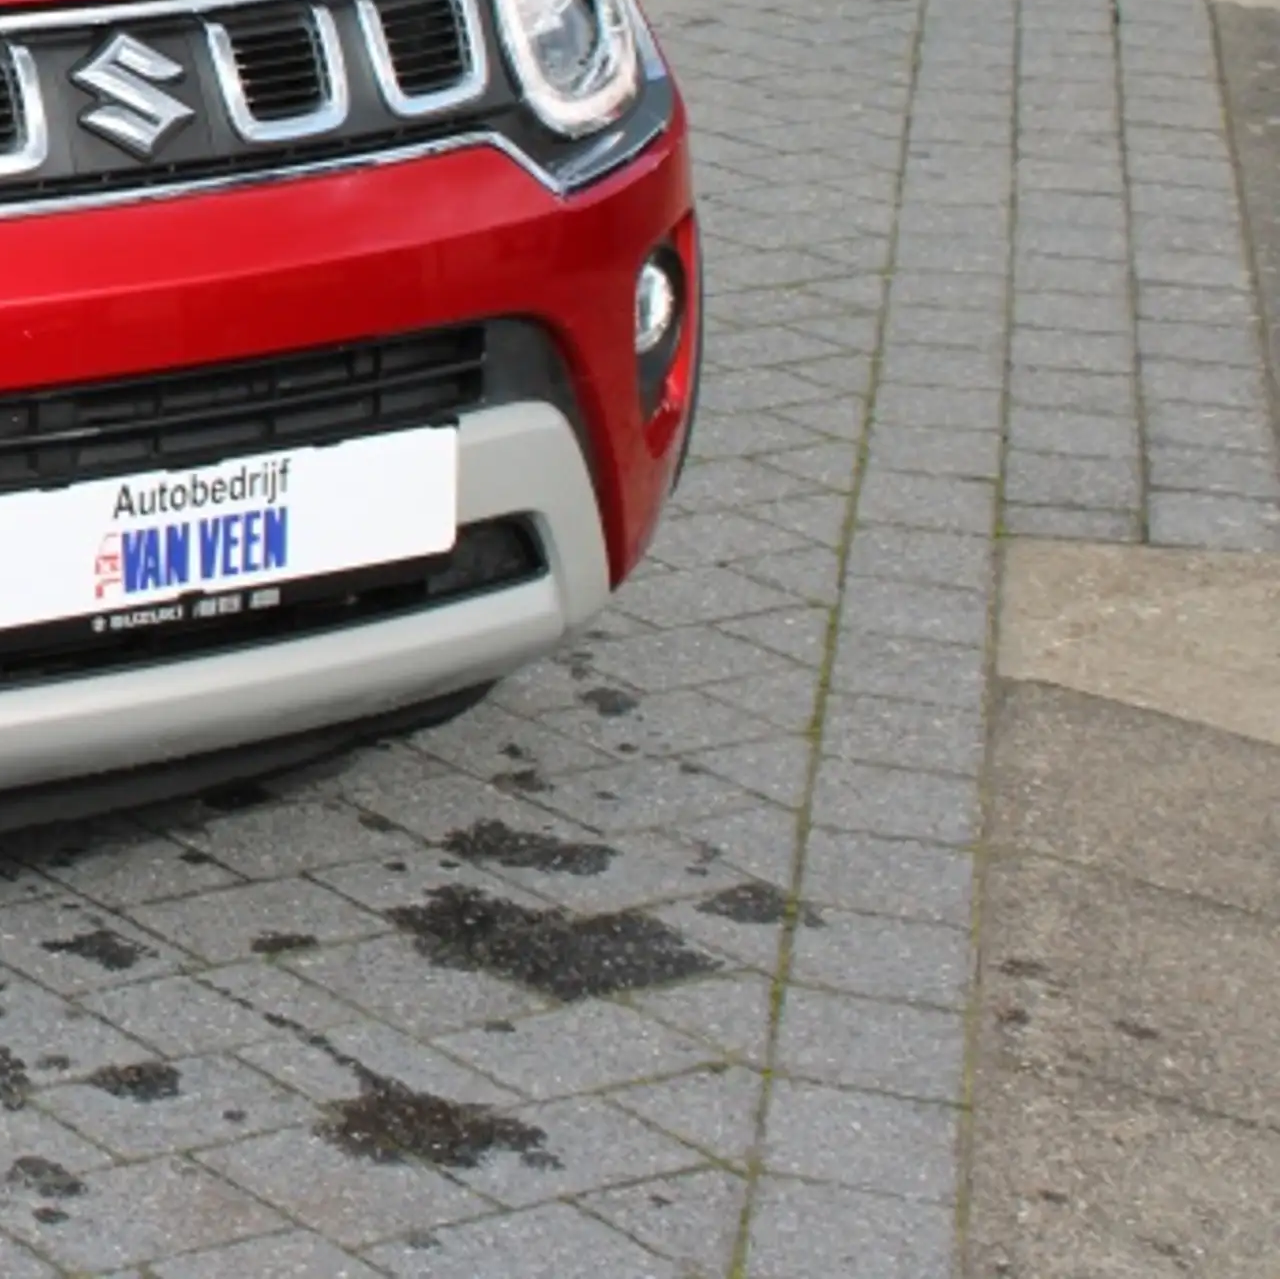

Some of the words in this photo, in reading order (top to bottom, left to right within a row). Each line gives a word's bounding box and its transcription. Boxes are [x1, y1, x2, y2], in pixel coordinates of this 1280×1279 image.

[113, 458, 290, 519] Autobedrijf
[121, 522, 189, 593] VAN
[199, 506, 288, 579] VEEN
